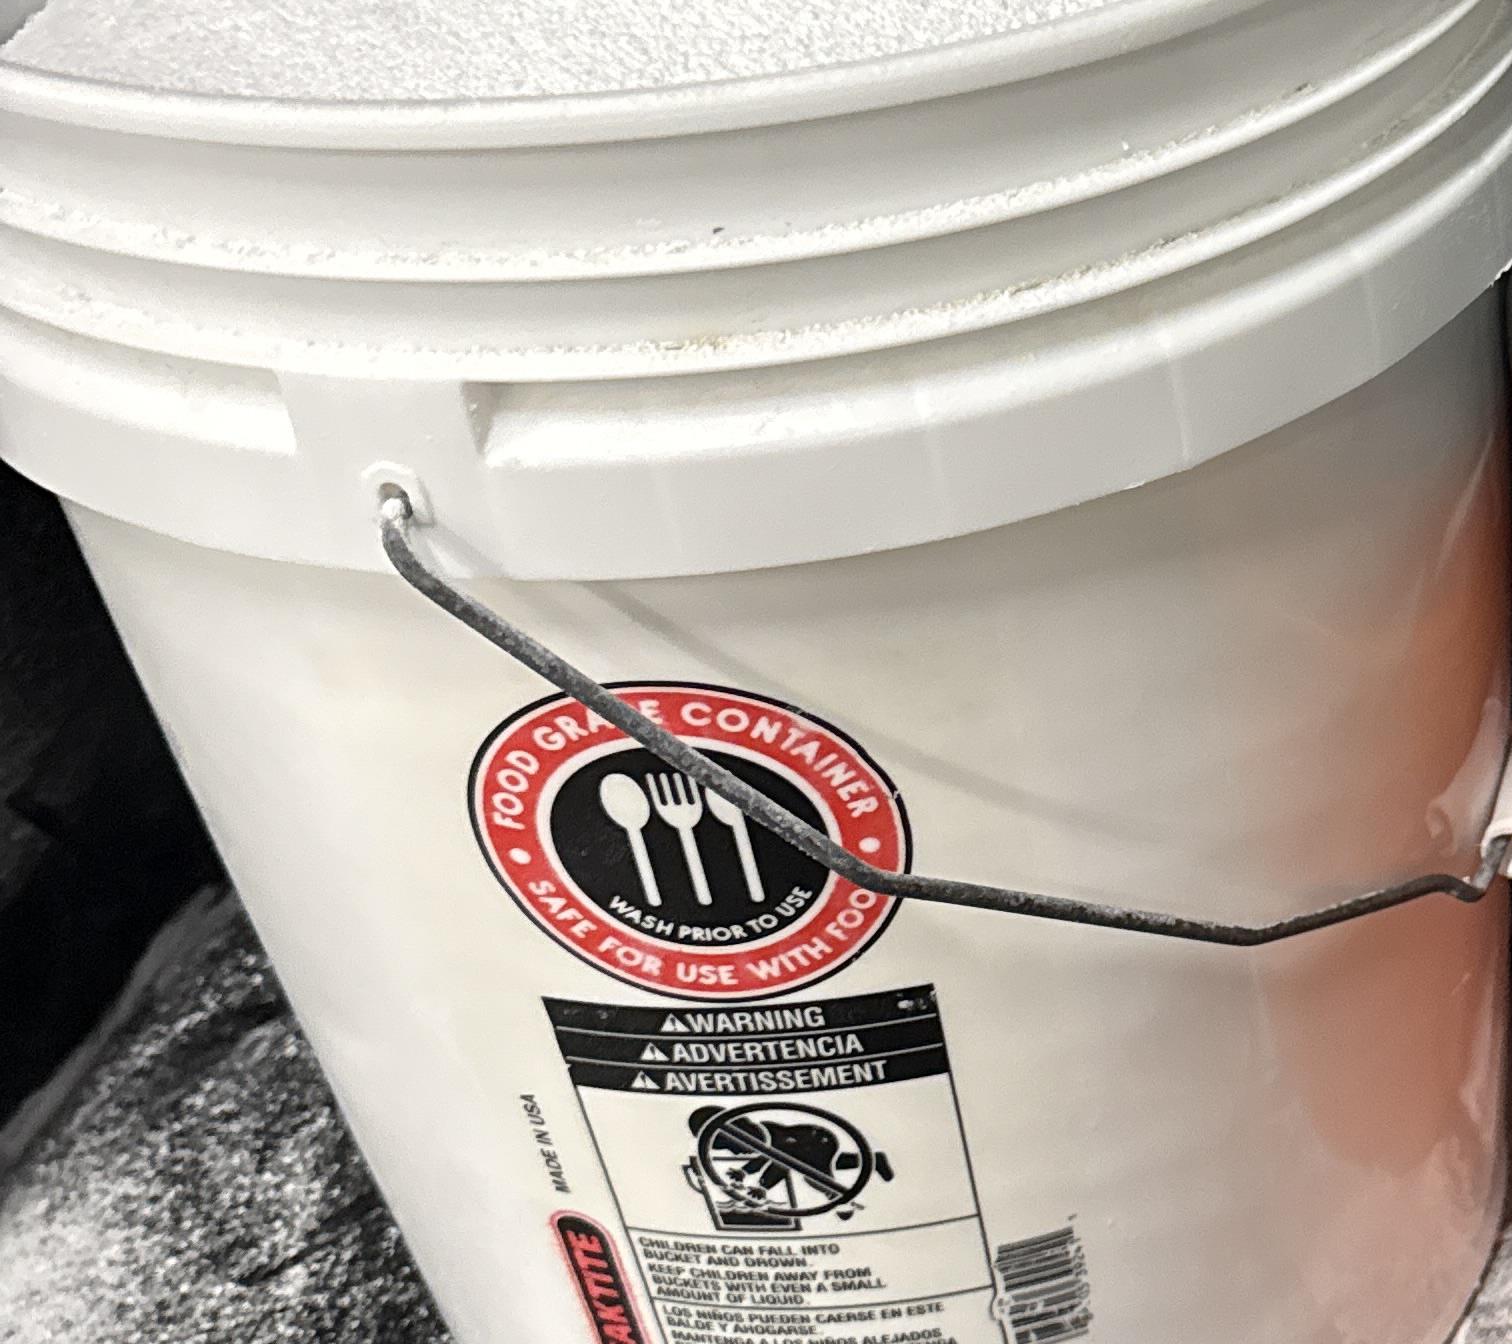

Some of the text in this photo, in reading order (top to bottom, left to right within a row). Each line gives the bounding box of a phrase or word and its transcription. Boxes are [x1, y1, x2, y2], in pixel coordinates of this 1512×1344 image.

[490, 699, 880, 831] FOOD GRAE CONTAINER
[608, 885, 815, 943] WASH PRIOR TO USE
[526, 878, 878, 986] SAFE FOR USE WITH FOO
[686, 1006, 826, 1034] WARNING
[671, 1032, 865, 1065] ADVERTENCIA
[664, 1059, 888, 1094] AVERTISSEMENT
[519, 1093, 572, 1194] MADE IN USA
[637, 1236, 841, 1256] CHILDREN CAN FALL INTO
[642, 1248, 702, 1265] BUCKET
[707, 1256, 741, 1267] AND
[648, 1262, 872, 1282] KEEP CHILDREN AWAY FROM
[652, 1274, 887, 1294] BUCKETS WITH EVEN A SMALL
[656, 1285, 722, 1303] AMOUNT
[726, 1293, 747, 1304] OF
[662, 1304, 692, 1318] LOS
[748, 1312, 811, 1324] PUEDEN
[815, 1309, 876, 1324] CAERSE
[880, 1307, 902, 1319] EN
[906, 1301, 945, 1317] ESTE
[666, 1316, 714, 1331] BALDE
[718, 1322, 729, 1333] Y
